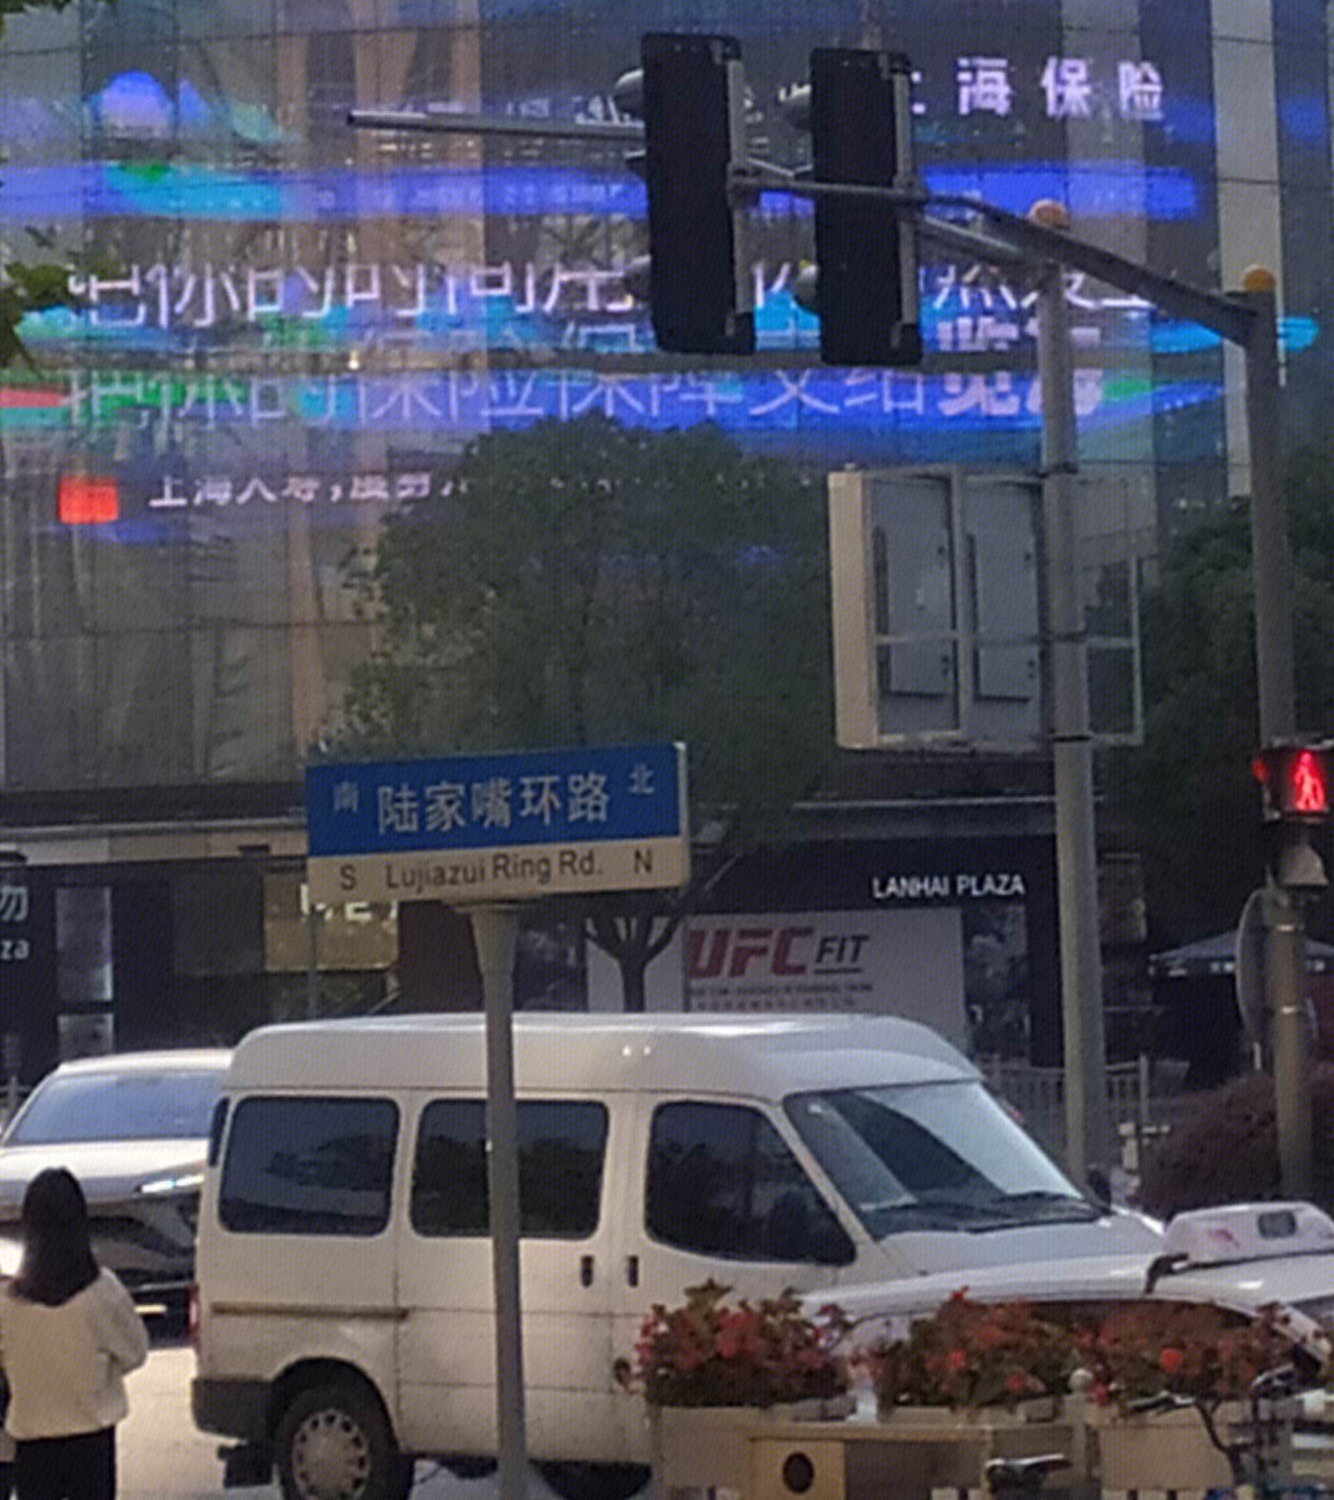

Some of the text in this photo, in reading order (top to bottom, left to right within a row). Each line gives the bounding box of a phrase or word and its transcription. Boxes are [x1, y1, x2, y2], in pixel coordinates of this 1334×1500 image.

[378, 772, 610, 836] 陆家嘴环路
[629, 763, 656, 795] 北
[339, 849, 653, 895] S Lujiazui Ring Rd. N
[871, 873, 1026, 900] LANHAI PLAZA
[688, 928, 870, 979] UFC FIT
